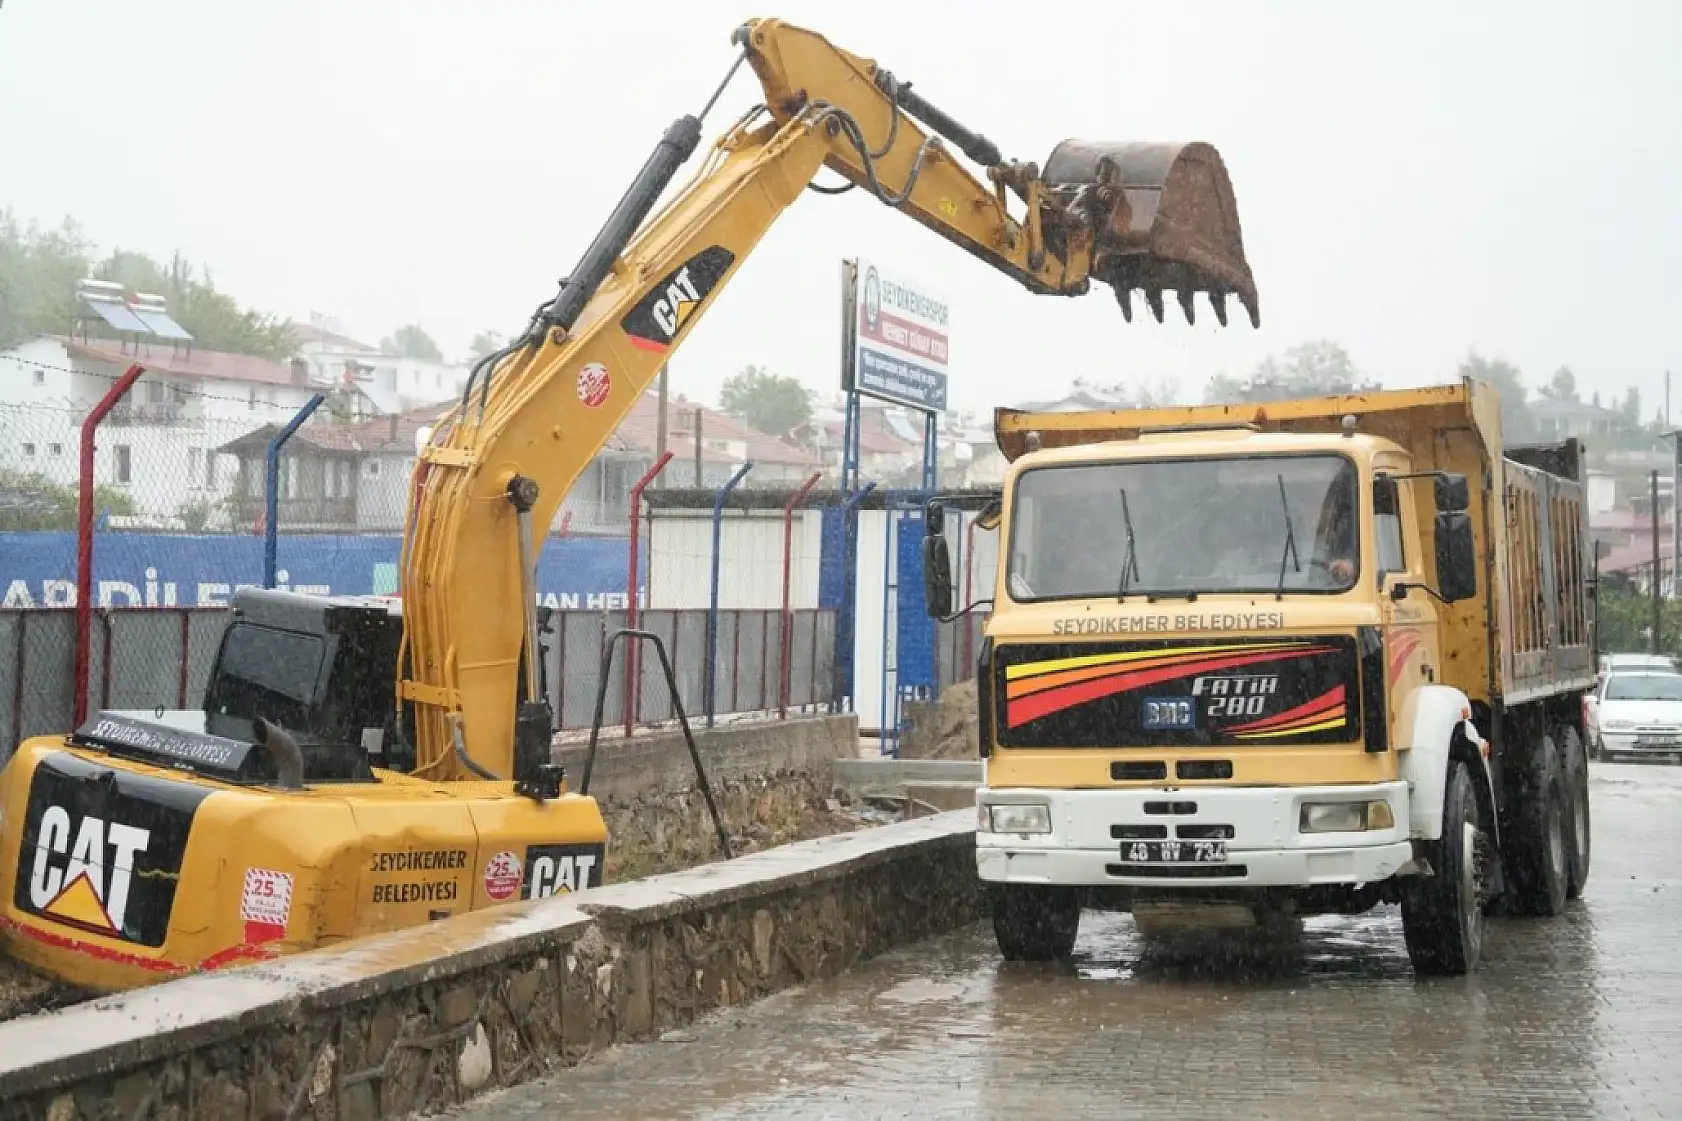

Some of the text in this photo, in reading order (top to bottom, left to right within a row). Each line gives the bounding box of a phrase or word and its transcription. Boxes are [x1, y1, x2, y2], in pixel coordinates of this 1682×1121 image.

[653, 266, 700, 336] CAT
[1175, 612, 1284, 630] BELEDİYESİ
[1208, 697, 1265, 717] 280
[31, 805, 150, 932] CAT
[370, 845, 467, 872] SEYDİKEMER
[493, 862, 509, 877] 25
[372, 876, 457, 904] BELEDİYESİ
[531, 855, 596, 900] CAT
